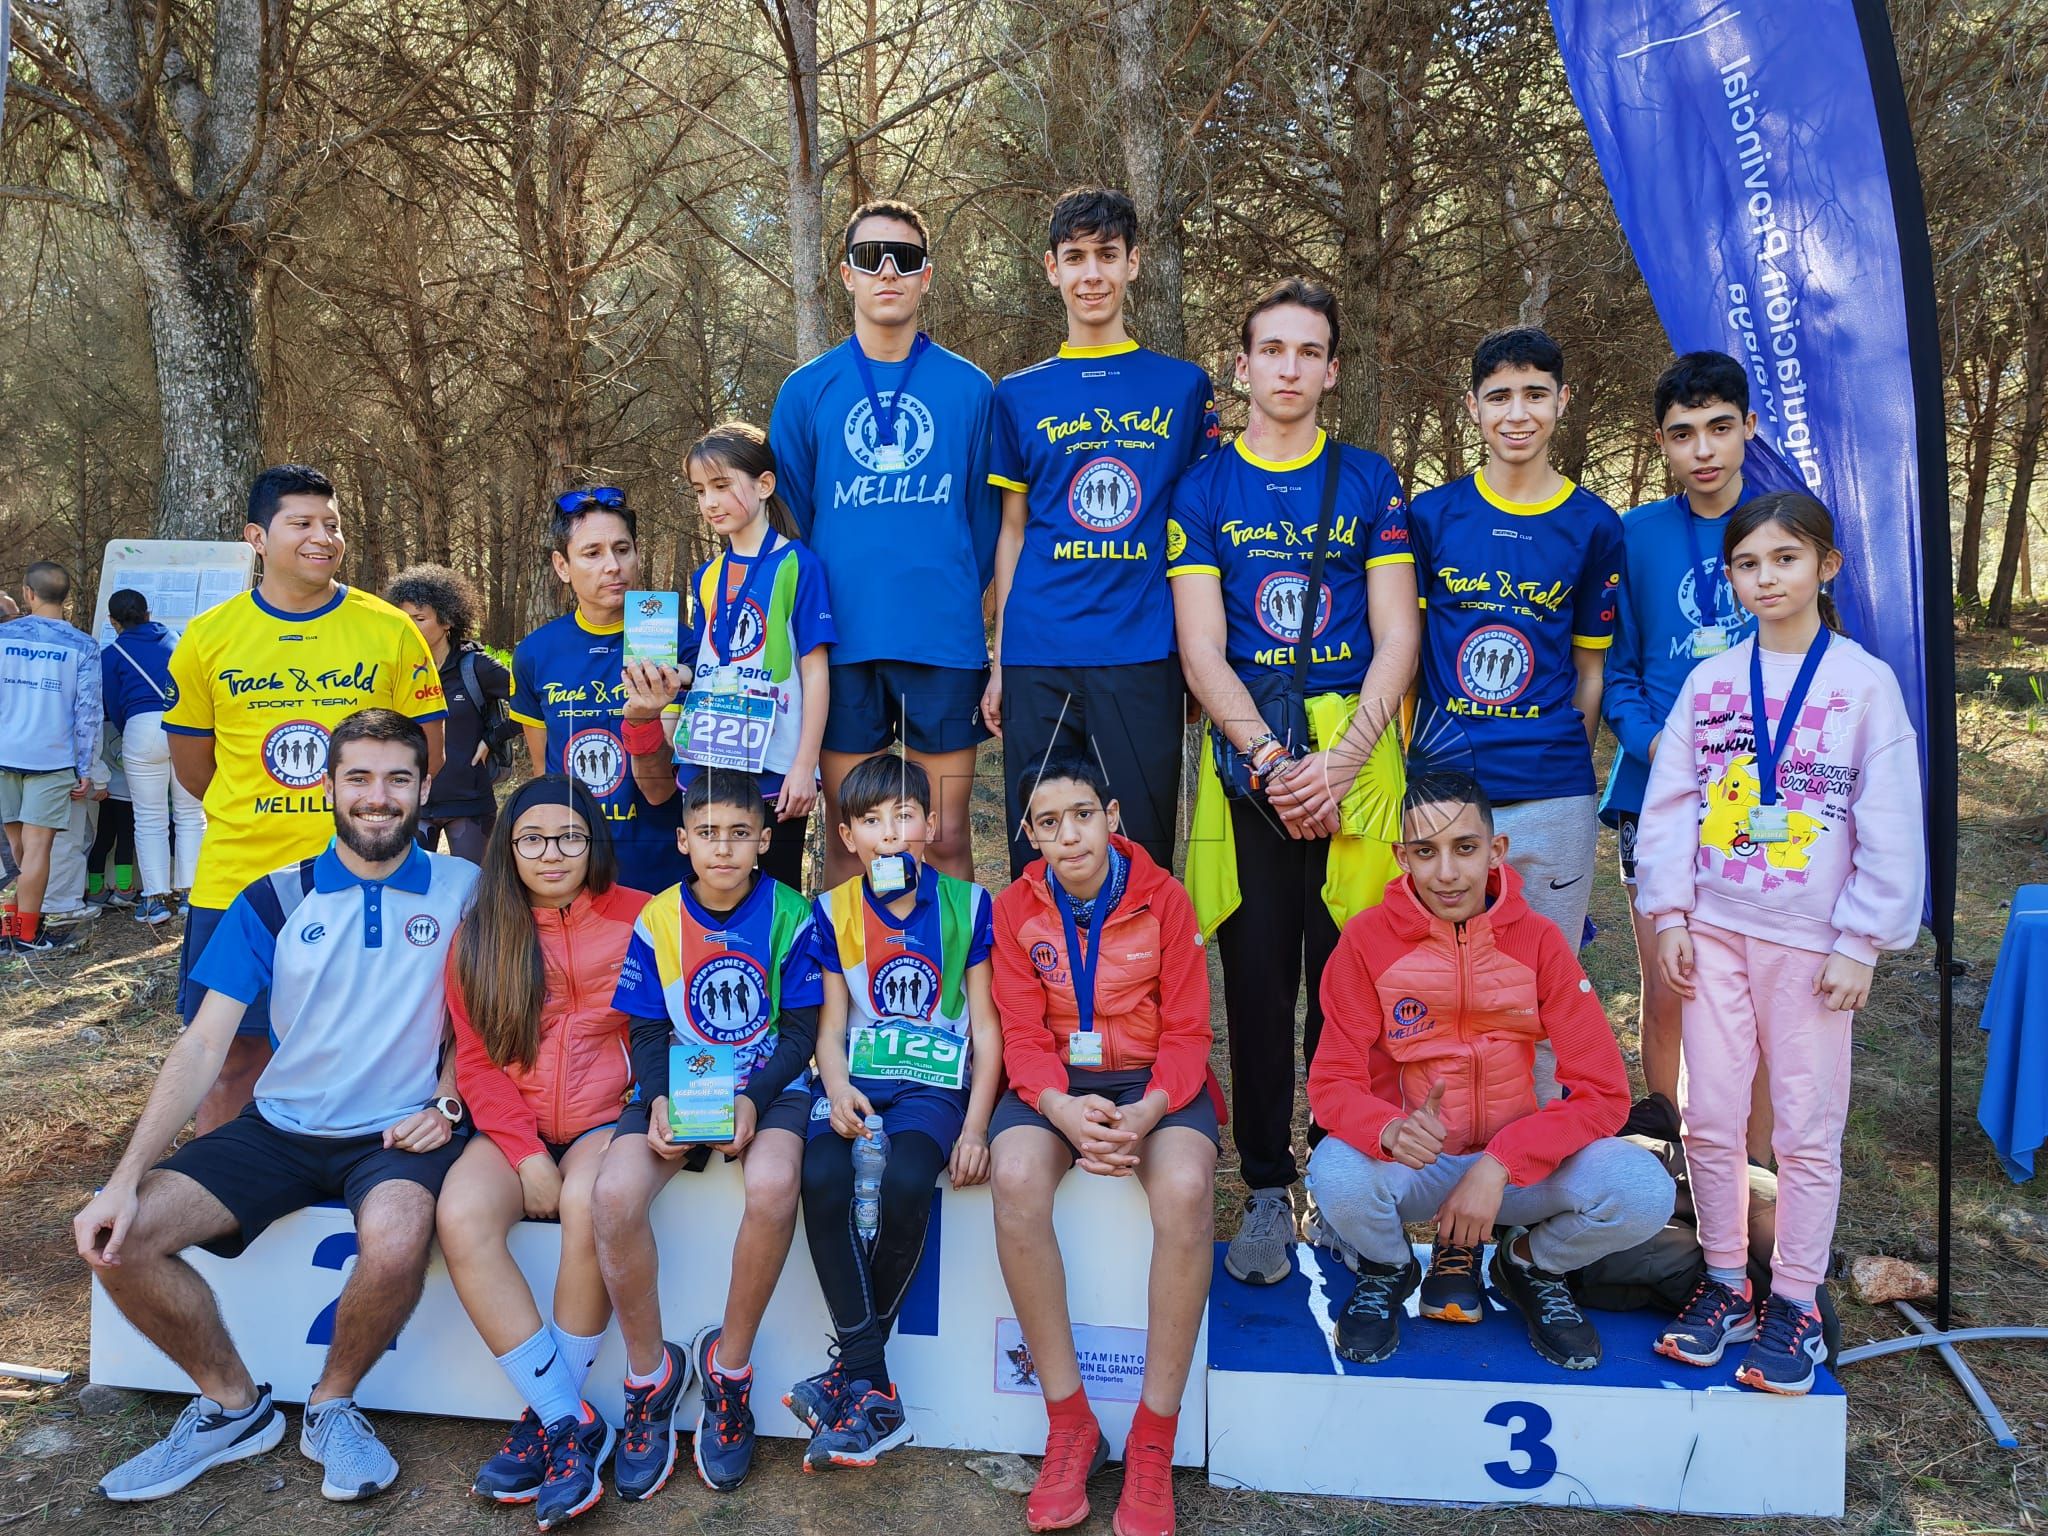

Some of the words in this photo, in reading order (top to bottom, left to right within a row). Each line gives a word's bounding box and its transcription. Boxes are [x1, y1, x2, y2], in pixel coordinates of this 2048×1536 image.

[848, 395, 908, 435] CAMPONS
[909, 401, 931, 434] PARA
[1036, 412, 1093, 444] Track
[1094, 407, 1120, 433] &
[1119, 406, 1174, 440] Field
[855, 447, 871, 465] LA
[1065, 440, 1110, 455] SPORT
[1114, 439, 1155, 450] TEAM
[833, 473, 953, 509] MELILLA
[1073, 462, 1120, 500] CAMPEONES
[1119, 469, 1137, 498] PARA
[1077, 508, 1089, 522] LA
[1090, 509, 1132, 528] CAÑADA
[1221, 519, 1279, 548] Track
[1280, 520, 1303, 546] &
[1301, 515, 1358, 547] Feld
[1053, 540, 1148, 561] MELILLA
[1246, 549, 1292, 561] SPORT
[1298, 550, 1341, 560] TEM
[1261, 576, 1305, 612] CAMPEONES
[1438, 567, 1491, 594] Track
[1496, 570, 1518, 600] &
[1518, 580, 1573, 612] Field
[1459, 601, 1506, 612] SPORT
[750, 604, 763, 635] PARA
[1269, 621, 1283, 635] LA
[6, 646, 68, 662] mayoral
[1254, 641, 1352, 666] MELLLA
[1463, 631, 1518, 662] CAMPEONES
[1517, 642, 1529, 674] PARA
[218, 668, 285, 697] Track
[288, 668, 316, 693] &
[316, 662, 379, 694] Field
[1464, 674, 1475, 690] LA
[1474, 684, 1520, 700] CAÑADA
[247, 700, 305, 709] SPORT
[311, 698, 358, 706] TEAM
[543, 682, 587, 705] Track
[591, 680, 611, 703] &
[557, 709, 602, 718] SPORT
[1445, 696, 1540, 719] MELILLA
[1695, 710, 1736, 727] PIKACHU
[266, 724, 317, 757] CAMPEONES
[693, 714, 765, 749] 220
[272, 767, 285, 781] LA
[255, 797, 334, 814] MELILL
[690, 958, 746, 1007] CAMPEONES
[874, 957, 921, 995] CAMPEONES
[921, 963, 938, 992] PARA
[698, 1019, 714, 1037] LA
[716, 1015, 767, 1042] CAÑADA
[1388, 1019, 1436, 1039] MELILLA
[880, 1068, 913, 1077] CARRERA
[1076, 1351, 1145, 1365] NTAMIENTO
[1096, 1363, 1107, 1374] EL
[1108, 1364, 1145, 1376] GRANDE
[1095, 1374, 1124, 1383] Deportes
[1484, 1400, 1557, 1490] 3
